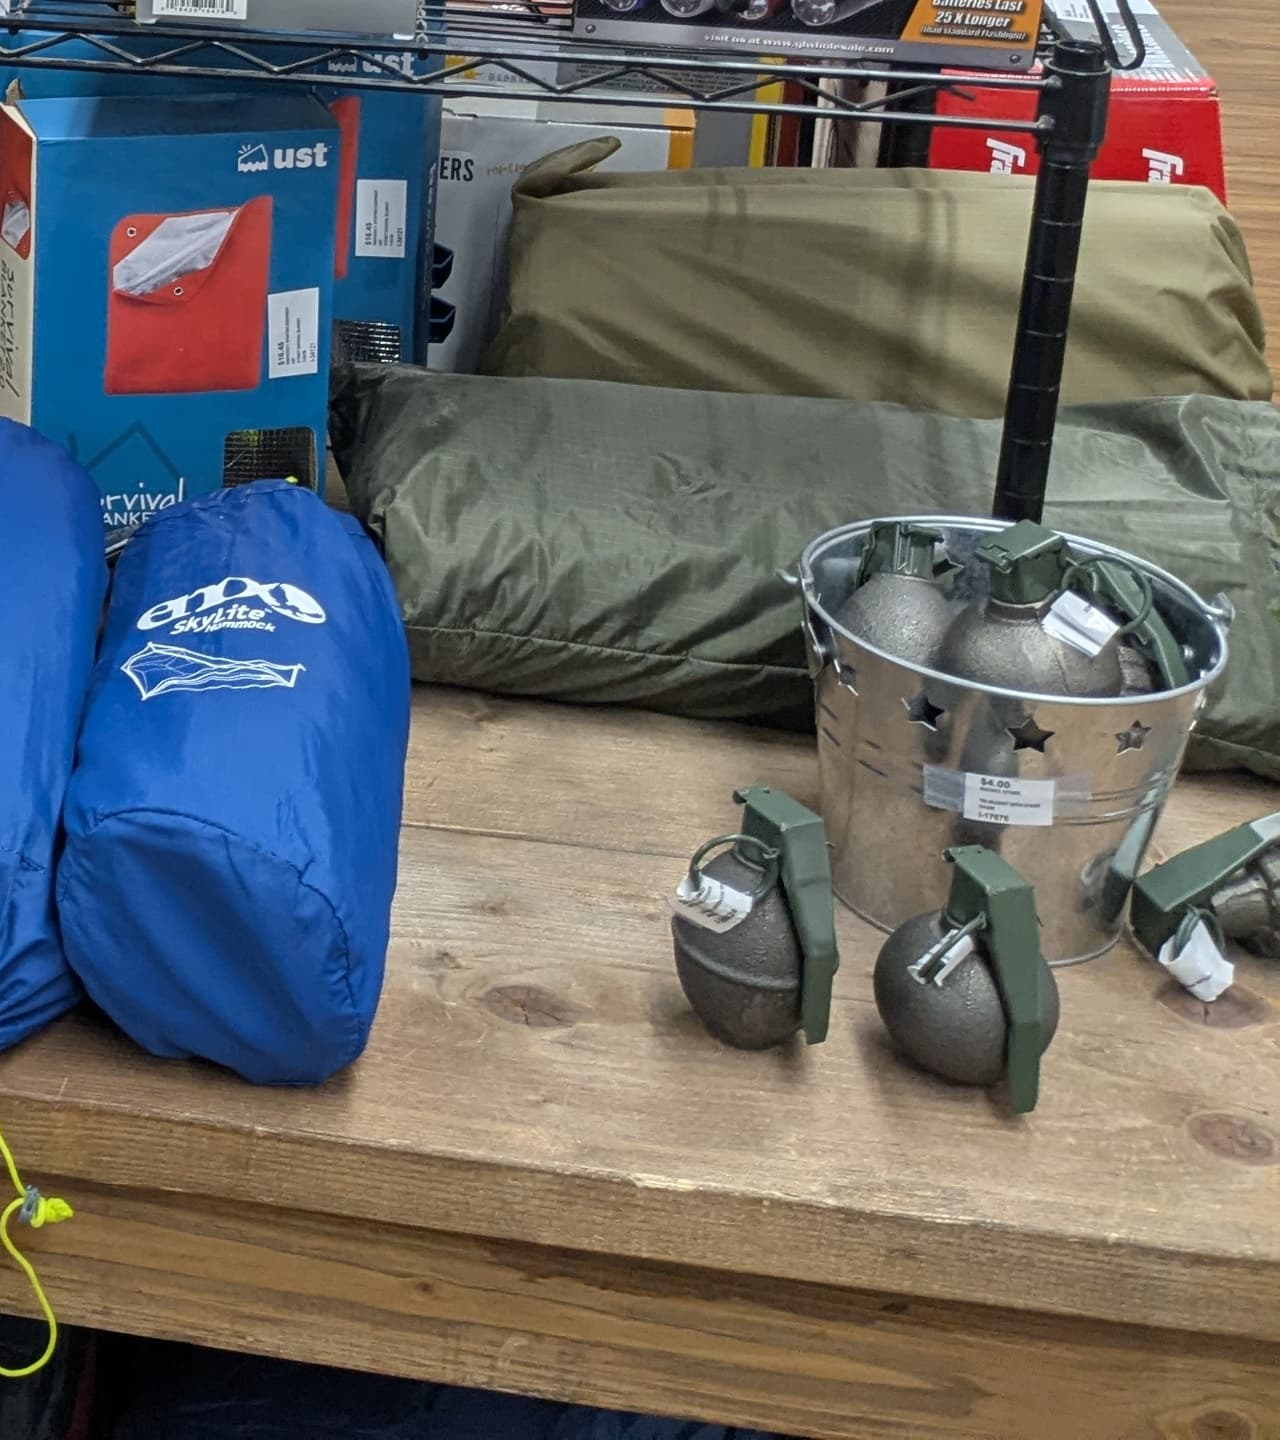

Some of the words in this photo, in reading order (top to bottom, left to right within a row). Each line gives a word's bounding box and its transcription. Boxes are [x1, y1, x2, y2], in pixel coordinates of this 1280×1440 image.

[934, 10, 953, 24] 25
[954, 12, 963, 25] X
[963, 13, 1011, 28] Longer
[273, 141, 329, 169] ust
[204, 620, 277, 633] Hammock
[979, 777, 1012, 790] $4.00
